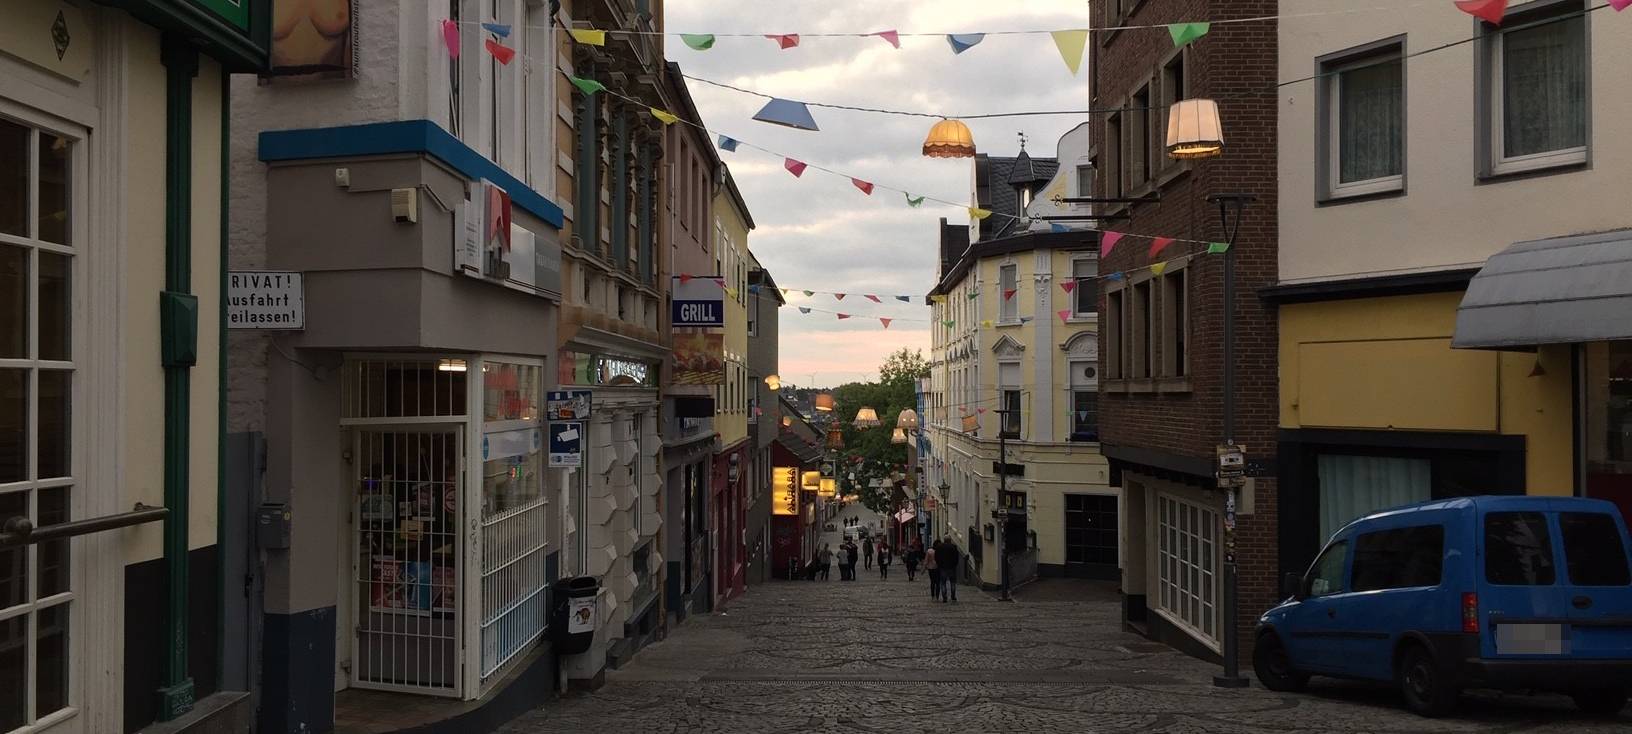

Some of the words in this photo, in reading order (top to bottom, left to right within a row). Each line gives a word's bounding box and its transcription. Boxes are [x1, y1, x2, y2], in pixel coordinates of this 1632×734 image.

[231, 275, 290, 289] RIVAT!
[230, 310, 295, 323] eilassen!
[681, 303, 716, 322] GRILL
